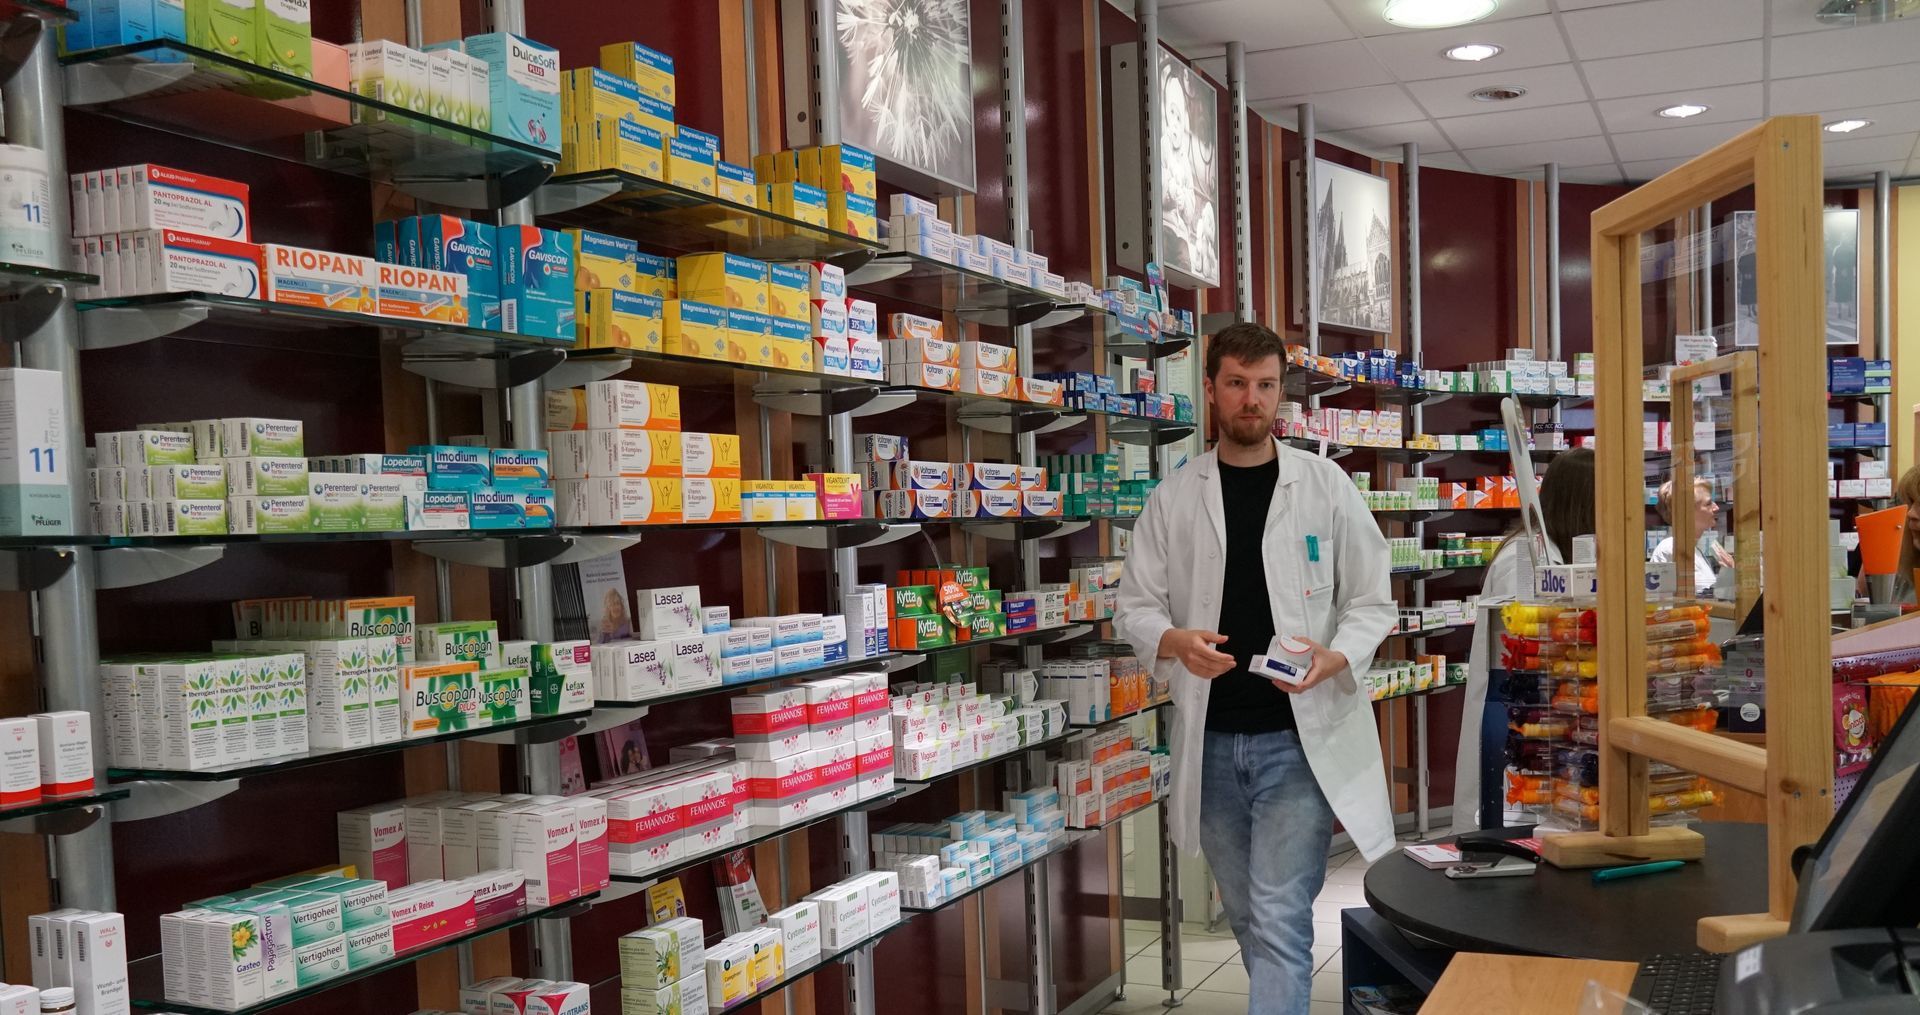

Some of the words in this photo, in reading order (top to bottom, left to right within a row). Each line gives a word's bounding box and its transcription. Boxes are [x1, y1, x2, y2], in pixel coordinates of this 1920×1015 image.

[512, 45, 556, 71] DulcoSoft
[635, 44, 659, 60] Magnesium
[659, 56, 673, 65] Verla
[529, 65, 543, 76] PLUS
[594, 70, 623, 86] Magnesium
[624, 78, 638, 91] Verla
[620, 119, 646, 134] Magnesium
[646, 129, 661, 140] Verla
[680, 128, 705, 141] Magnesium
[705, 136, 719, 145] Verla
[671, 138, 698, 152] Magnesium
[699, 147, 713, 157] Verla
[841, 147, 863, 160] Magnesium
[718, 162, 741, 176] Magnesium
[153, 190, 202, 204] PANTOPRAZOL
[153, 197, 162, 205] 20
[22, 203, 41, 224] 11
[583, 234, 615, 247] Magnesium
[615, 241, 630, 250] Verla
[450, 241, 492, 258] GAVISCON
[169, 254, 217, 268] PANTOPRAZOL
[276, 247, 363, 277] RIOPAN
[528, 250, 568, 266] GAVISCON
[169, 261, 177, 269] 20
[726, 257, 751, 271] Magnesium
[751, 263, 764, 274] Verla
[772, 267, 795, 279] Magnesium
[379, 266, 457, 294] RIOPAN
[615, 293, 643, 305] Magnesium
[643, 298, 656, 306] Verla
[682, 302, 707, 315] Magnesium
[708, 308, 720, 318] Verla
[729, 311, 753, 322] Magnesium
[753, 317, 765, 326] Verla
[774, 318, 796, 330] Magnesium
[851, 319, 861, 329] 375
[926, 340, 943, 350] Voltaren
[979, 343, 999, 355] Voltaren
[853, 360, 863, 369] 375
[925, 365, 943, 375] Voltaren
[979, 371, 999, 381] Voltaren
[265, 423, 298, 433] Perenterol
[159, 434, 191, 445] Perenterol
[29, 447, 54, 473] 11
[382, 455, 423, 469] Lopedium
[436, 451, 478, 463] Imodium
[495, 454, 538, 465] Imodium
[270, 461, 304, 470] Perenterol
[920, 466, 937, 475] Voltaren
[983, 467, 1001, 476] Voltaren
[190, 469, 221, 477] Perenterol
[323, 483, 358, 493] Perenterol
[368, 484, 401, 493] Perenterol
[424, 494, 464, 505] Lopedium
[473, 491, 514, 503] Imodium
[525, 493, 546, 504] dium
[190, 504, 221, 512] Perenterol
[271, 499, 305, 508] Perenterol
[35, 517, 62, 526] PFLÜGER
[956, 570, 973, 585] Kytta
[1541, 569, 1566, 593] Bloc
[943, 584, 960, 594] 50%
[654, 592, 684, 606] Lasea
[896, 590, 917, 607] Kytta
[1045, 593, 1055, 603] ABC
[708, 611, 728, 619] Neurexan
[1045, 611, 1054, 621] ABC
[351, 621, 412, 637] Buscopan
[778, 622, 799, 632] Neurexan
[802, 620, 821, 628] Neurexan
[918, 620, 938, 637] Kytta
[971, 616, 990, 633] Kytta
[727, 635, 747, 644] Neurexan
[752, 632, 770, 641] Neurexan
[445, 640, 492, 658] Buscopan
[555, 647, 572, 657] Lefax
[675, 641, 704, 656] Lasea
[780, 648, 800, 658] Neurexan
[802, 646, 822, 655] Neurexan
[508, 655, 528, 666] Lefax
[628, 649, 656, 665] Lasea
[755, 656, 773, 665] Neurexan
[371, 666, 397, 674] Iberogast
[731, 659, 750, 669] Neurexan
[341, 668, 367, 677] Iberogast
[249, 683, 276, 692] Iberogast
[277, 679, 304, 688] Iberogast
[566, 680, 585, 692] Lefax
[188, 689, 215, 699] Iberogast
[219, 686, 247, 695] Iberogast
[416, 687, 477, 707] Buscopan
[857, 693, 884, 705] FEMANNOSE
[458, 701, 477, 713] PLUS
[816, 702, 850, 715] FEMANNOSE
[965, 703, 979, 713] Vagisan
[771, 707, 804, 724] FEMANNOSE
[909, 717, 926, 728] Vagisan
[981, 731, 995, 742] Vagisan
[862, 751, 890, 765] FEMANNOSE
[920, 750, 938, 762] Vagisan
[821, 762, 853, 776] FEMANNOSE
[782, 773, 815, 788] FEMANNOSE
[690, 800, 728, 816] FEMANNOSE
[579, 820, 601, 833] Vomex
[600, 818, 606, 826] A
[635, 812, 677, 832] FEMANNOSE
[373, 824, 396, 838] Vomex
[397, 823, 403, 834] A
[547, 828, 568, 840] Vomex
[568, 826, 574, 835] A
[491, 882, 498, 891] A
[343, 890, 386, 908] Vertigoheel
[293, 904, 339, 925] Vertigoheel
[391, 906, 410, 919] Vomex
[411, 904, 418, 914] A
[419, 900, 435, 911] Reise
[839, 907, 857, 922] Cystinol
[99, 926, 117, 934] WALA
[786, 924, 806, 941] Cystinol
[806, 920, 818, 931] akut
[349, 928, 391, 948] Vertigoheel
[298, 943, 344, 965] Vertigoheel
[236, 958, 261, 973] Gasteo
[560, 1002, 588, 1015] ELOTRANS
